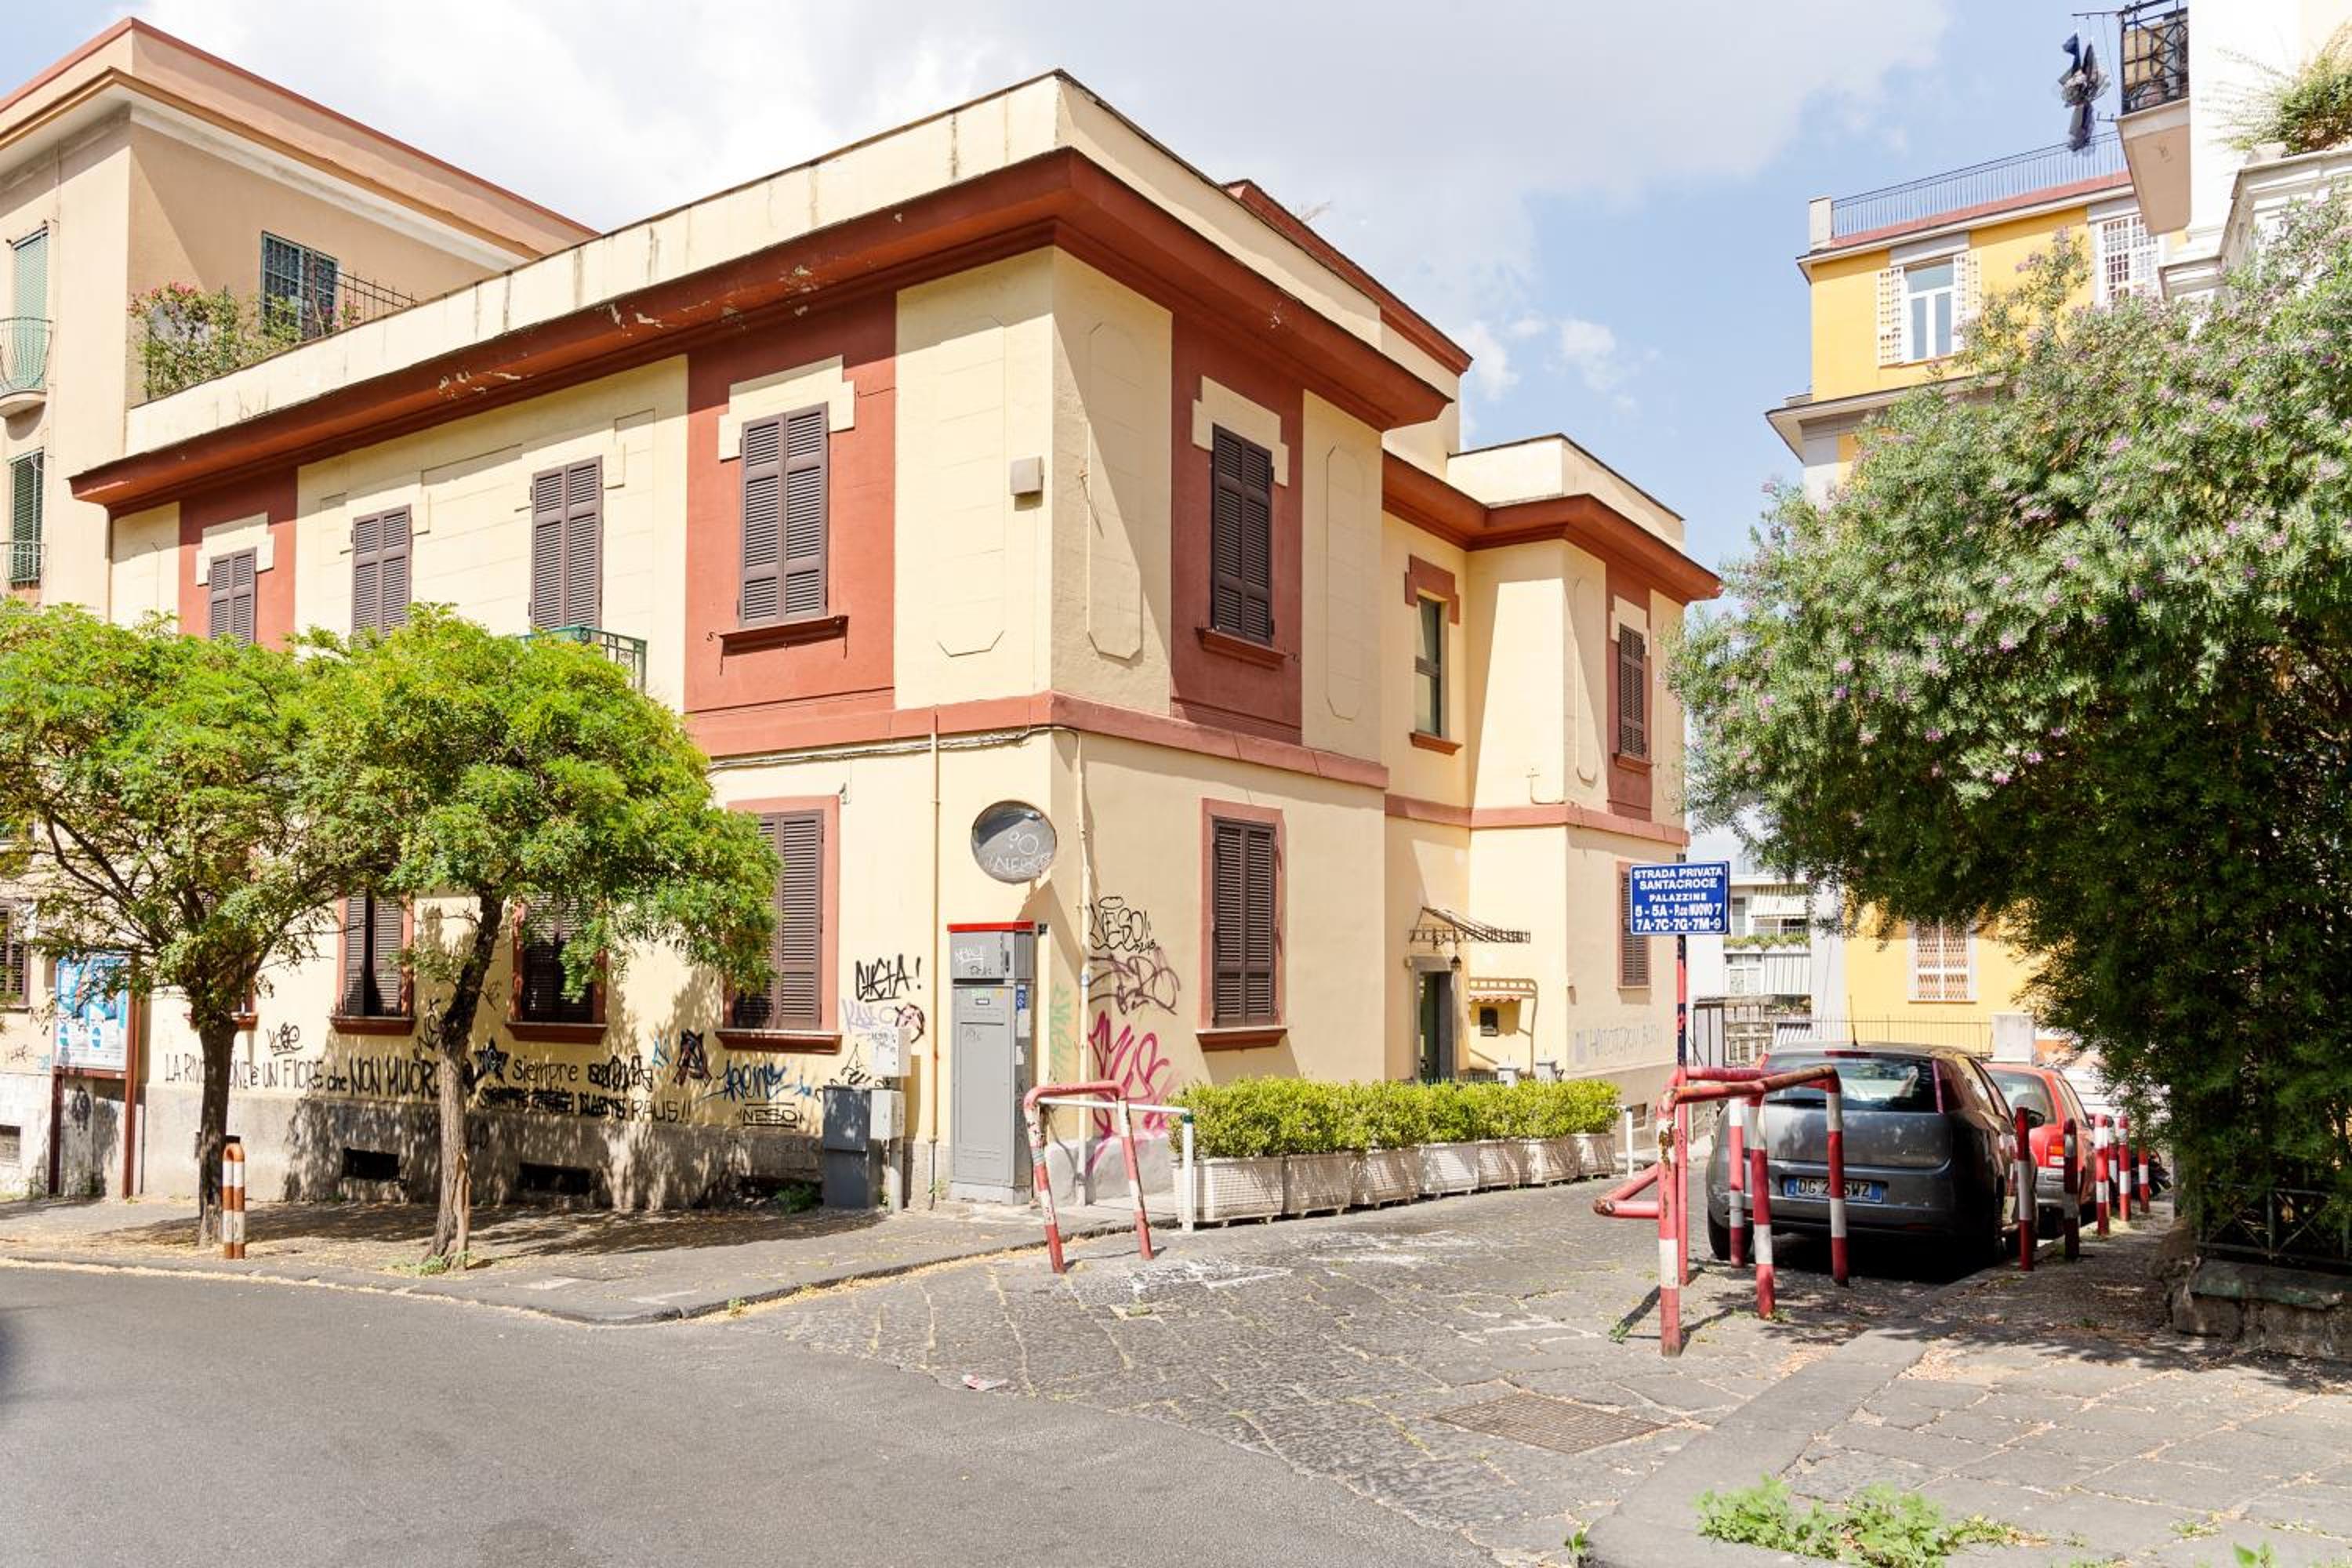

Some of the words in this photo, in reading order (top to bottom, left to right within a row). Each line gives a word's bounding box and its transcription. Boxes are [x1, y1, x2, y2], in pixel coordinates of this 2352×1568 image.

[1634, 869, 1676, 879] STRADA
[1679, 866, 1723, 877] PRIVATA
[1639, 878, 1718, 890] SANTACROCE
[1649, 892, 1707, 902] PALAZZINE
[1651, 904, 1668, 916] 5A
[1715, 903, 1722, 915] 7
[165, 1053, 180, 1082] LA
[263, 1060, 278, 1087] UN
[283, 1059, 325, 1092] FIORE
[327, 1066, 347, 1091] che
[350, 1056, 381, 1096] NON
